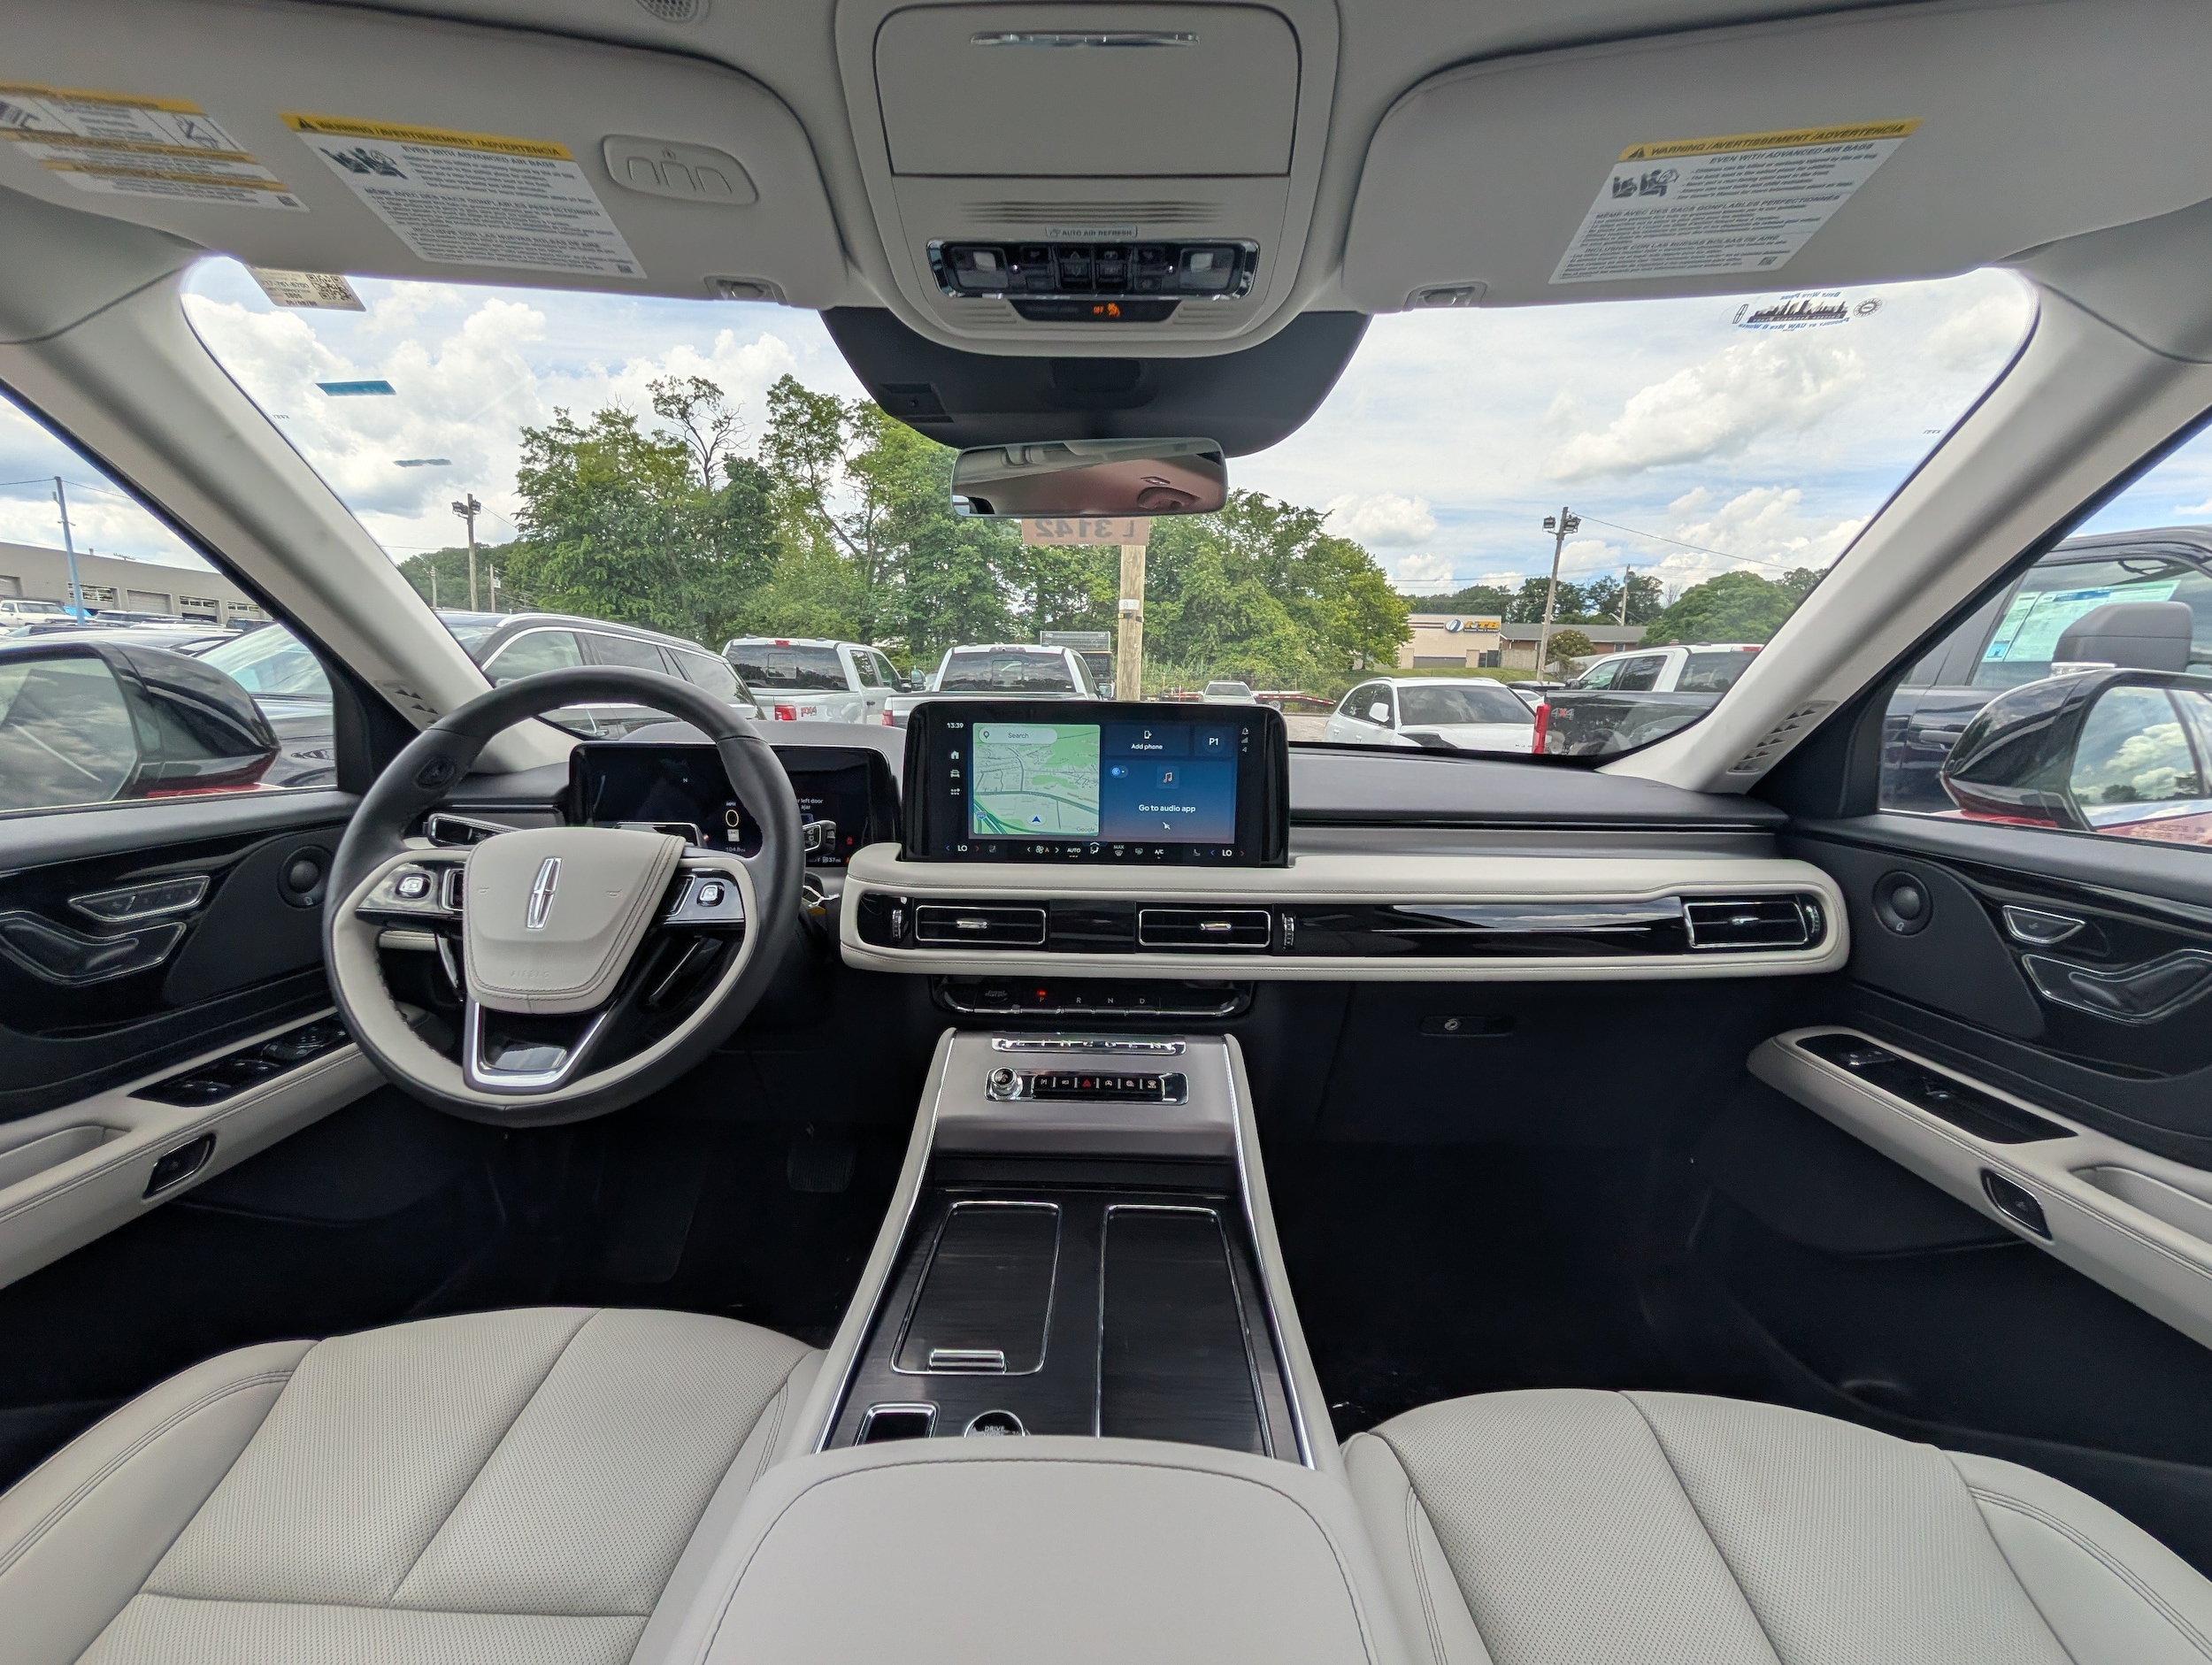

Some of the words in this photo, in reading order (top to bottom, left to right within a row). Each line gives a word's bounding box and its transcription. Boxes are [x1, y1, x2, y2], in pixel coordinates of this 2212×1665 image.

[1648, 142, 1708, 156] WARNING
[1708, 154, 1739, 164] EVEN
[1763, 147, 1824, 159] ADVANCED
[1820, 145, 1844, 154] AIR
[1464, 620, 1500, 629] NTB
[726, 809, 740, 827] 0
[1222, 848, 1233, 857] LO
